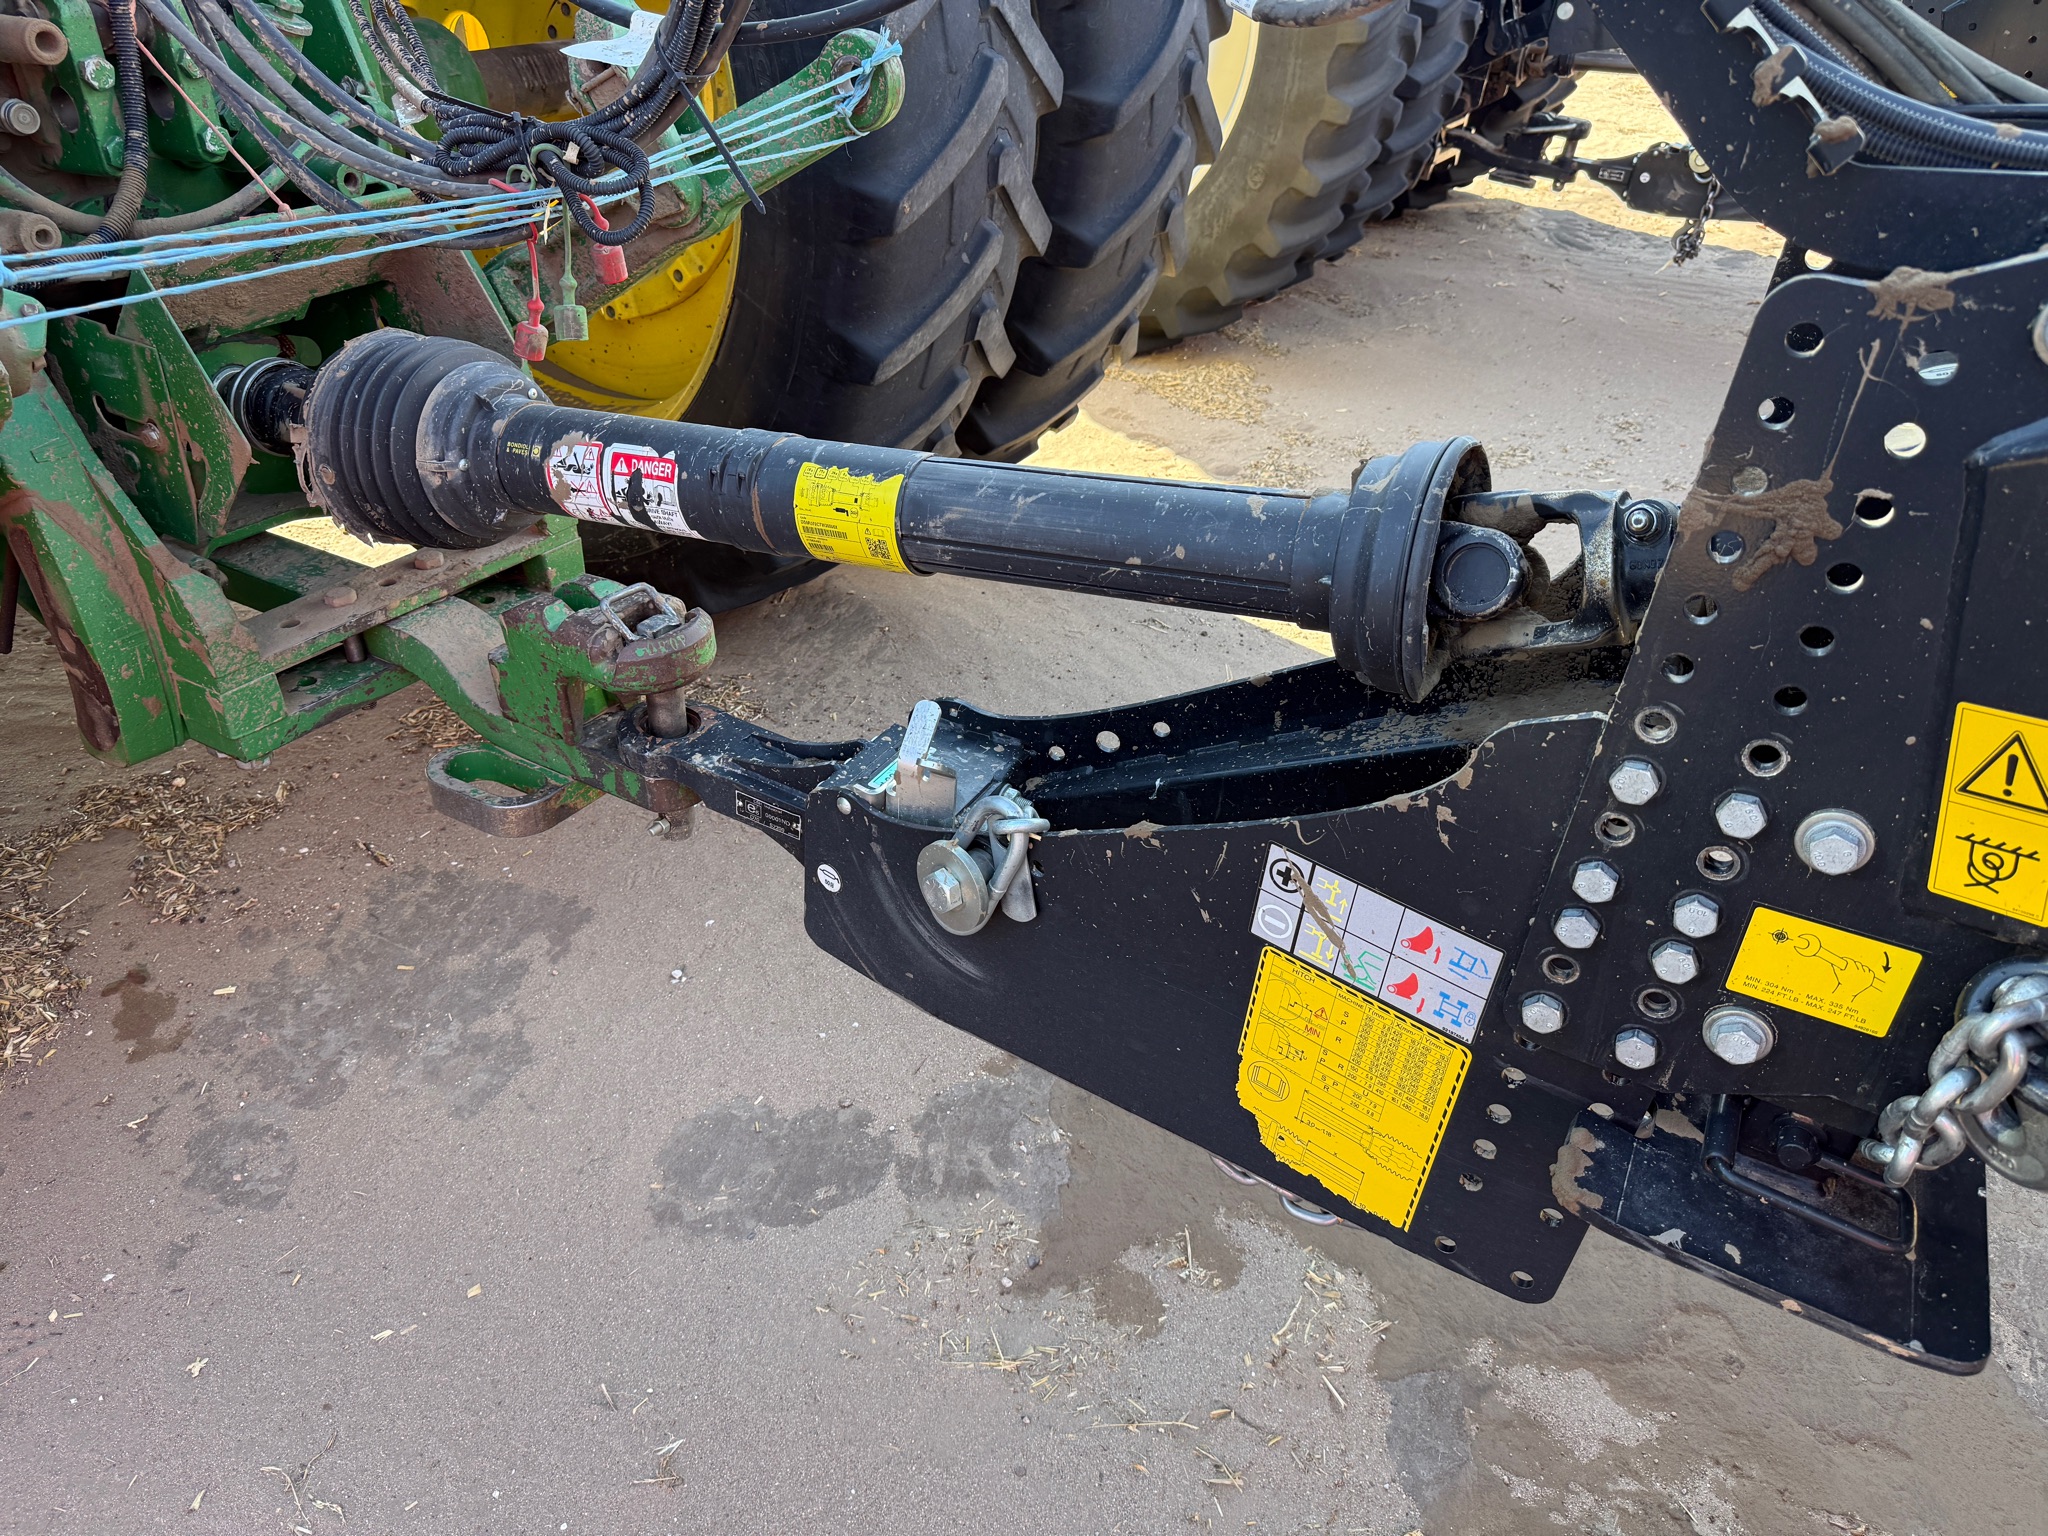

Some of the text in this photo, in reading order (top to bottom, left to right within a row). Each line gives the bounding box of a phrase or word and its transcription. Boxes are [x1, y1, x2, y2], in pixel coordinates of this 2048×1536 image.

[631, 458, 673, 478] DANGER
[1291, 967, 1315, 983] HITCH
[1338, 993, 1364, 1009] MACHINE
[1742, 981, 1760, 992] MIN.
[1761, 987, 1776, 996] 224
[1776, 991, 1799, 1003] FT.LB
[1805, 1001, 1827, 1012] MAX.
[1827, 1008, 1843, 1017] 247
[1843, 1013, 1867, 1025] FT.LB
[1744, 974, 1762, 985] MIN.
[1764, 980, 1780, 989] 304
[1781, 985, 1795, 994] Nm
[1805, 993, 1826, 1004] MAX.
[1845, 1005, 1859, 1015] Nm
[1303, 1023, 1321, 1038] MIN
